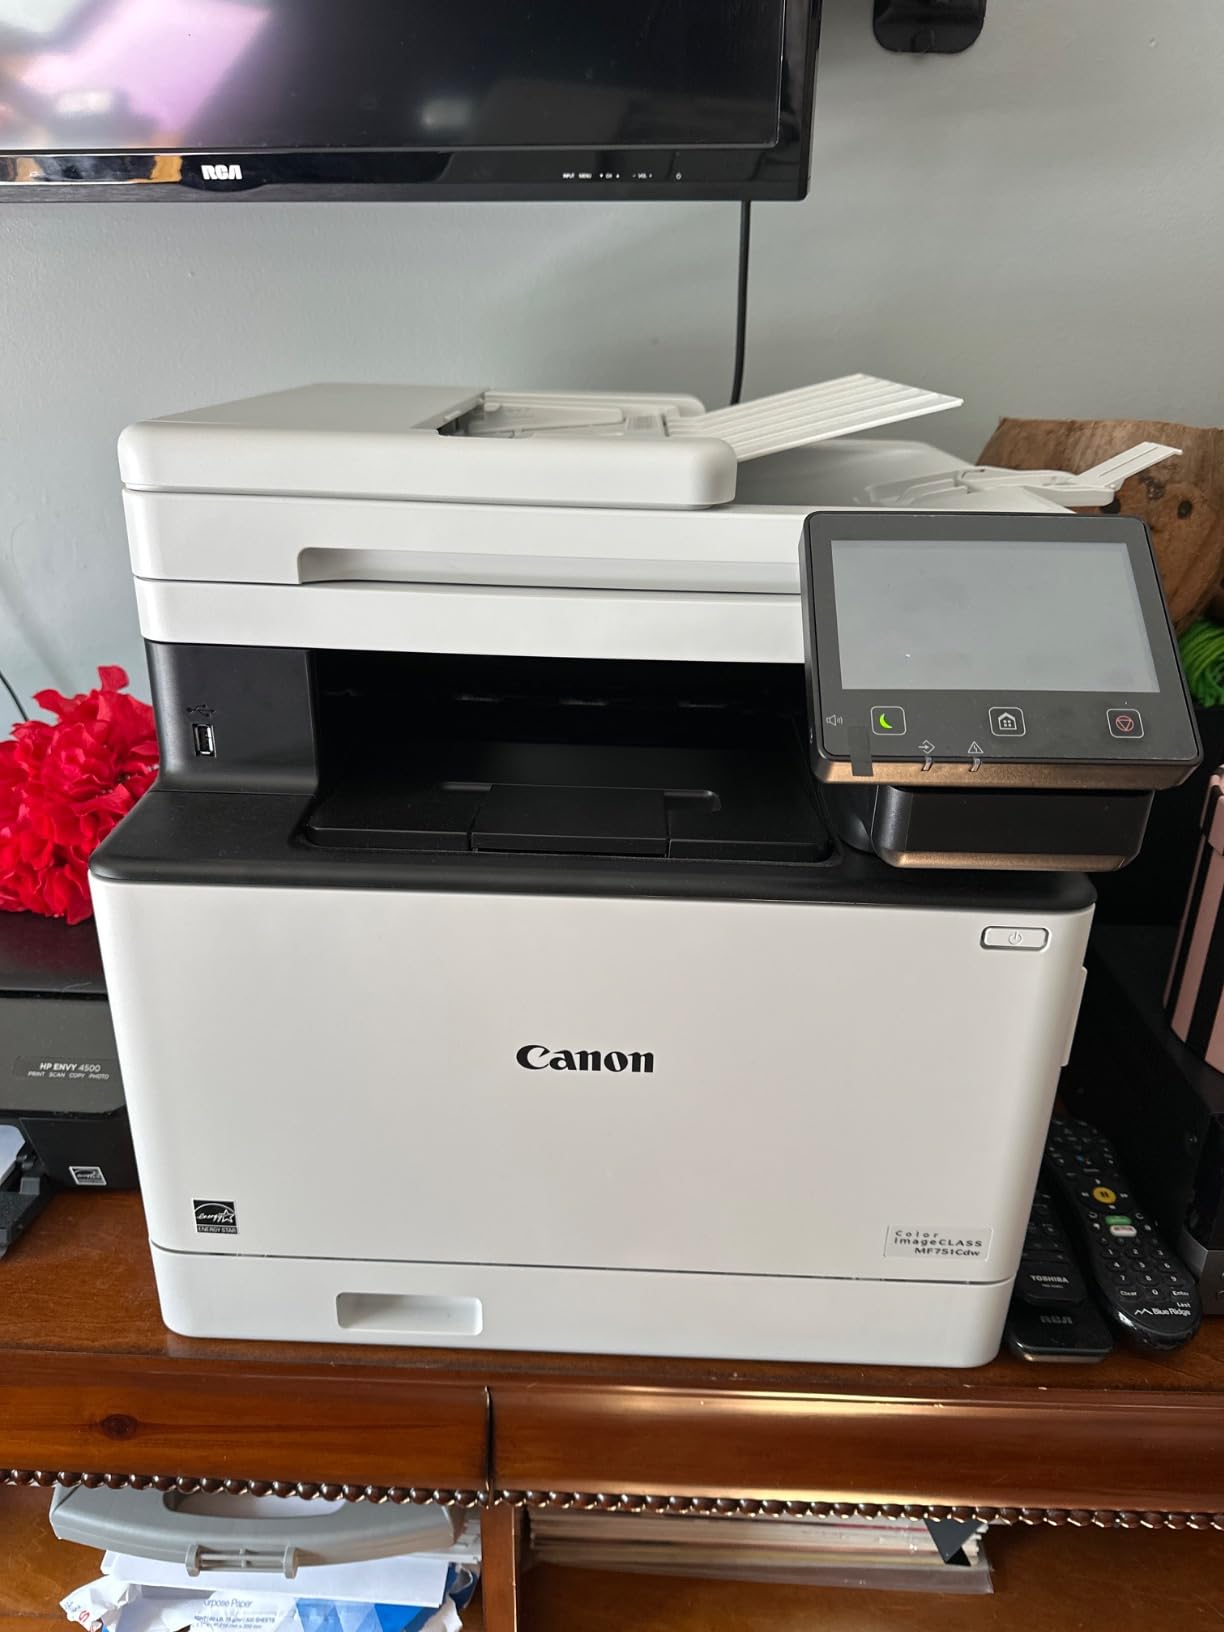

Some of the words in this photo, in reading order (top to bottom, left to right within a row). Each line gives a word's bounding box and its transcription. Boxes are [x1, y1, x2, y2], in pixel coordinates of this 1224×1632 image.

[201, 164, 243, 180] RCA
[516, 1044, 654, 1073] Canon
[40, 1062, 52, 1070] HP
[53, 1063, 77, 1071] ENVY
[78, 1064, 101, 1072] 4500
[895, 1230, 939, 1238] Color
[894, 1237, 983, 1247] imageCLASS
[914, 1247, 980, 1257] MF751Cdw
[1030, 1274, 1070, 1284] TOSHIBA
[1151, 1307, 1169, 1315] Blue
[1168, 1307, 1191, 1317] Ridge
[231, 1598, 253, 1608] Paper
